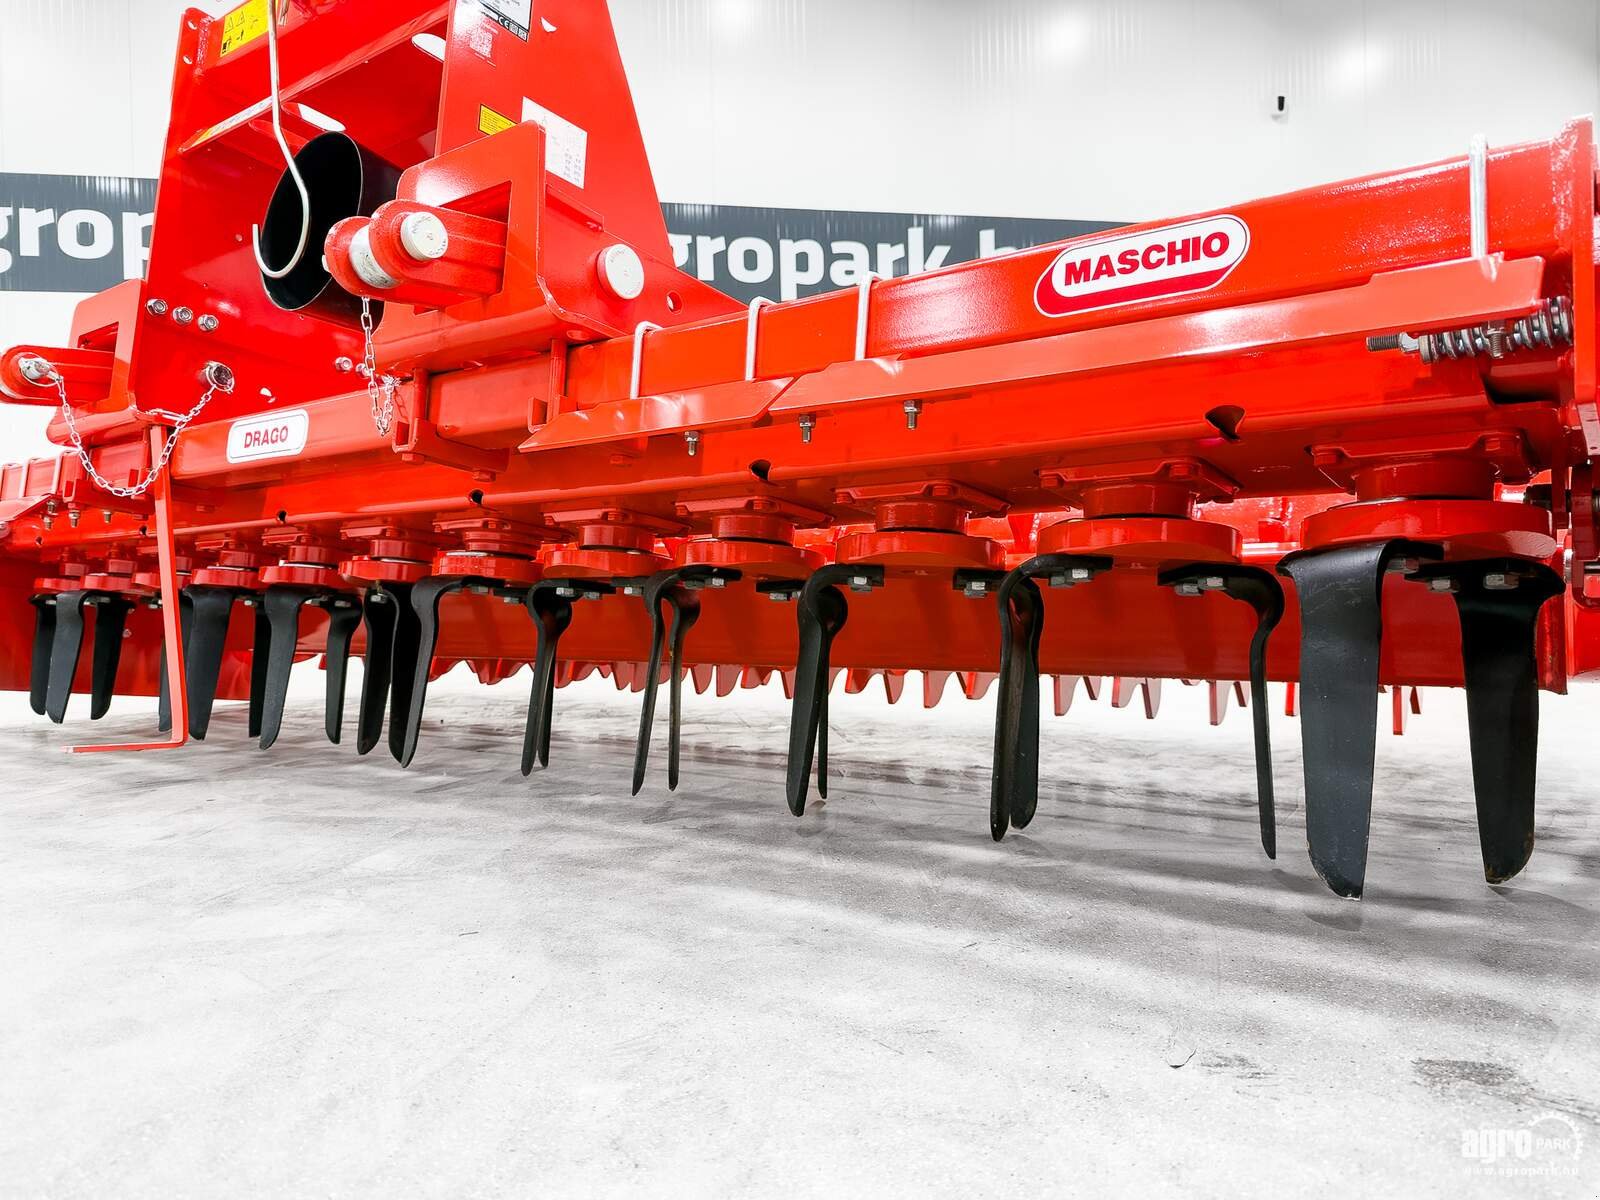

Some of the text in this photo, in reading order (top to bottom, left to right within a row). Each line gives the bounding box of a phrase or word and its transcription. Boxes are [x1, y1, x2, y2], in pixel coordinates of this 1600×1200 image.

[668, 226, 951, 301] ropark
[1064, 231, 1230, 287] MASCHIO
[244, 425, 289, 449] DRAGO
